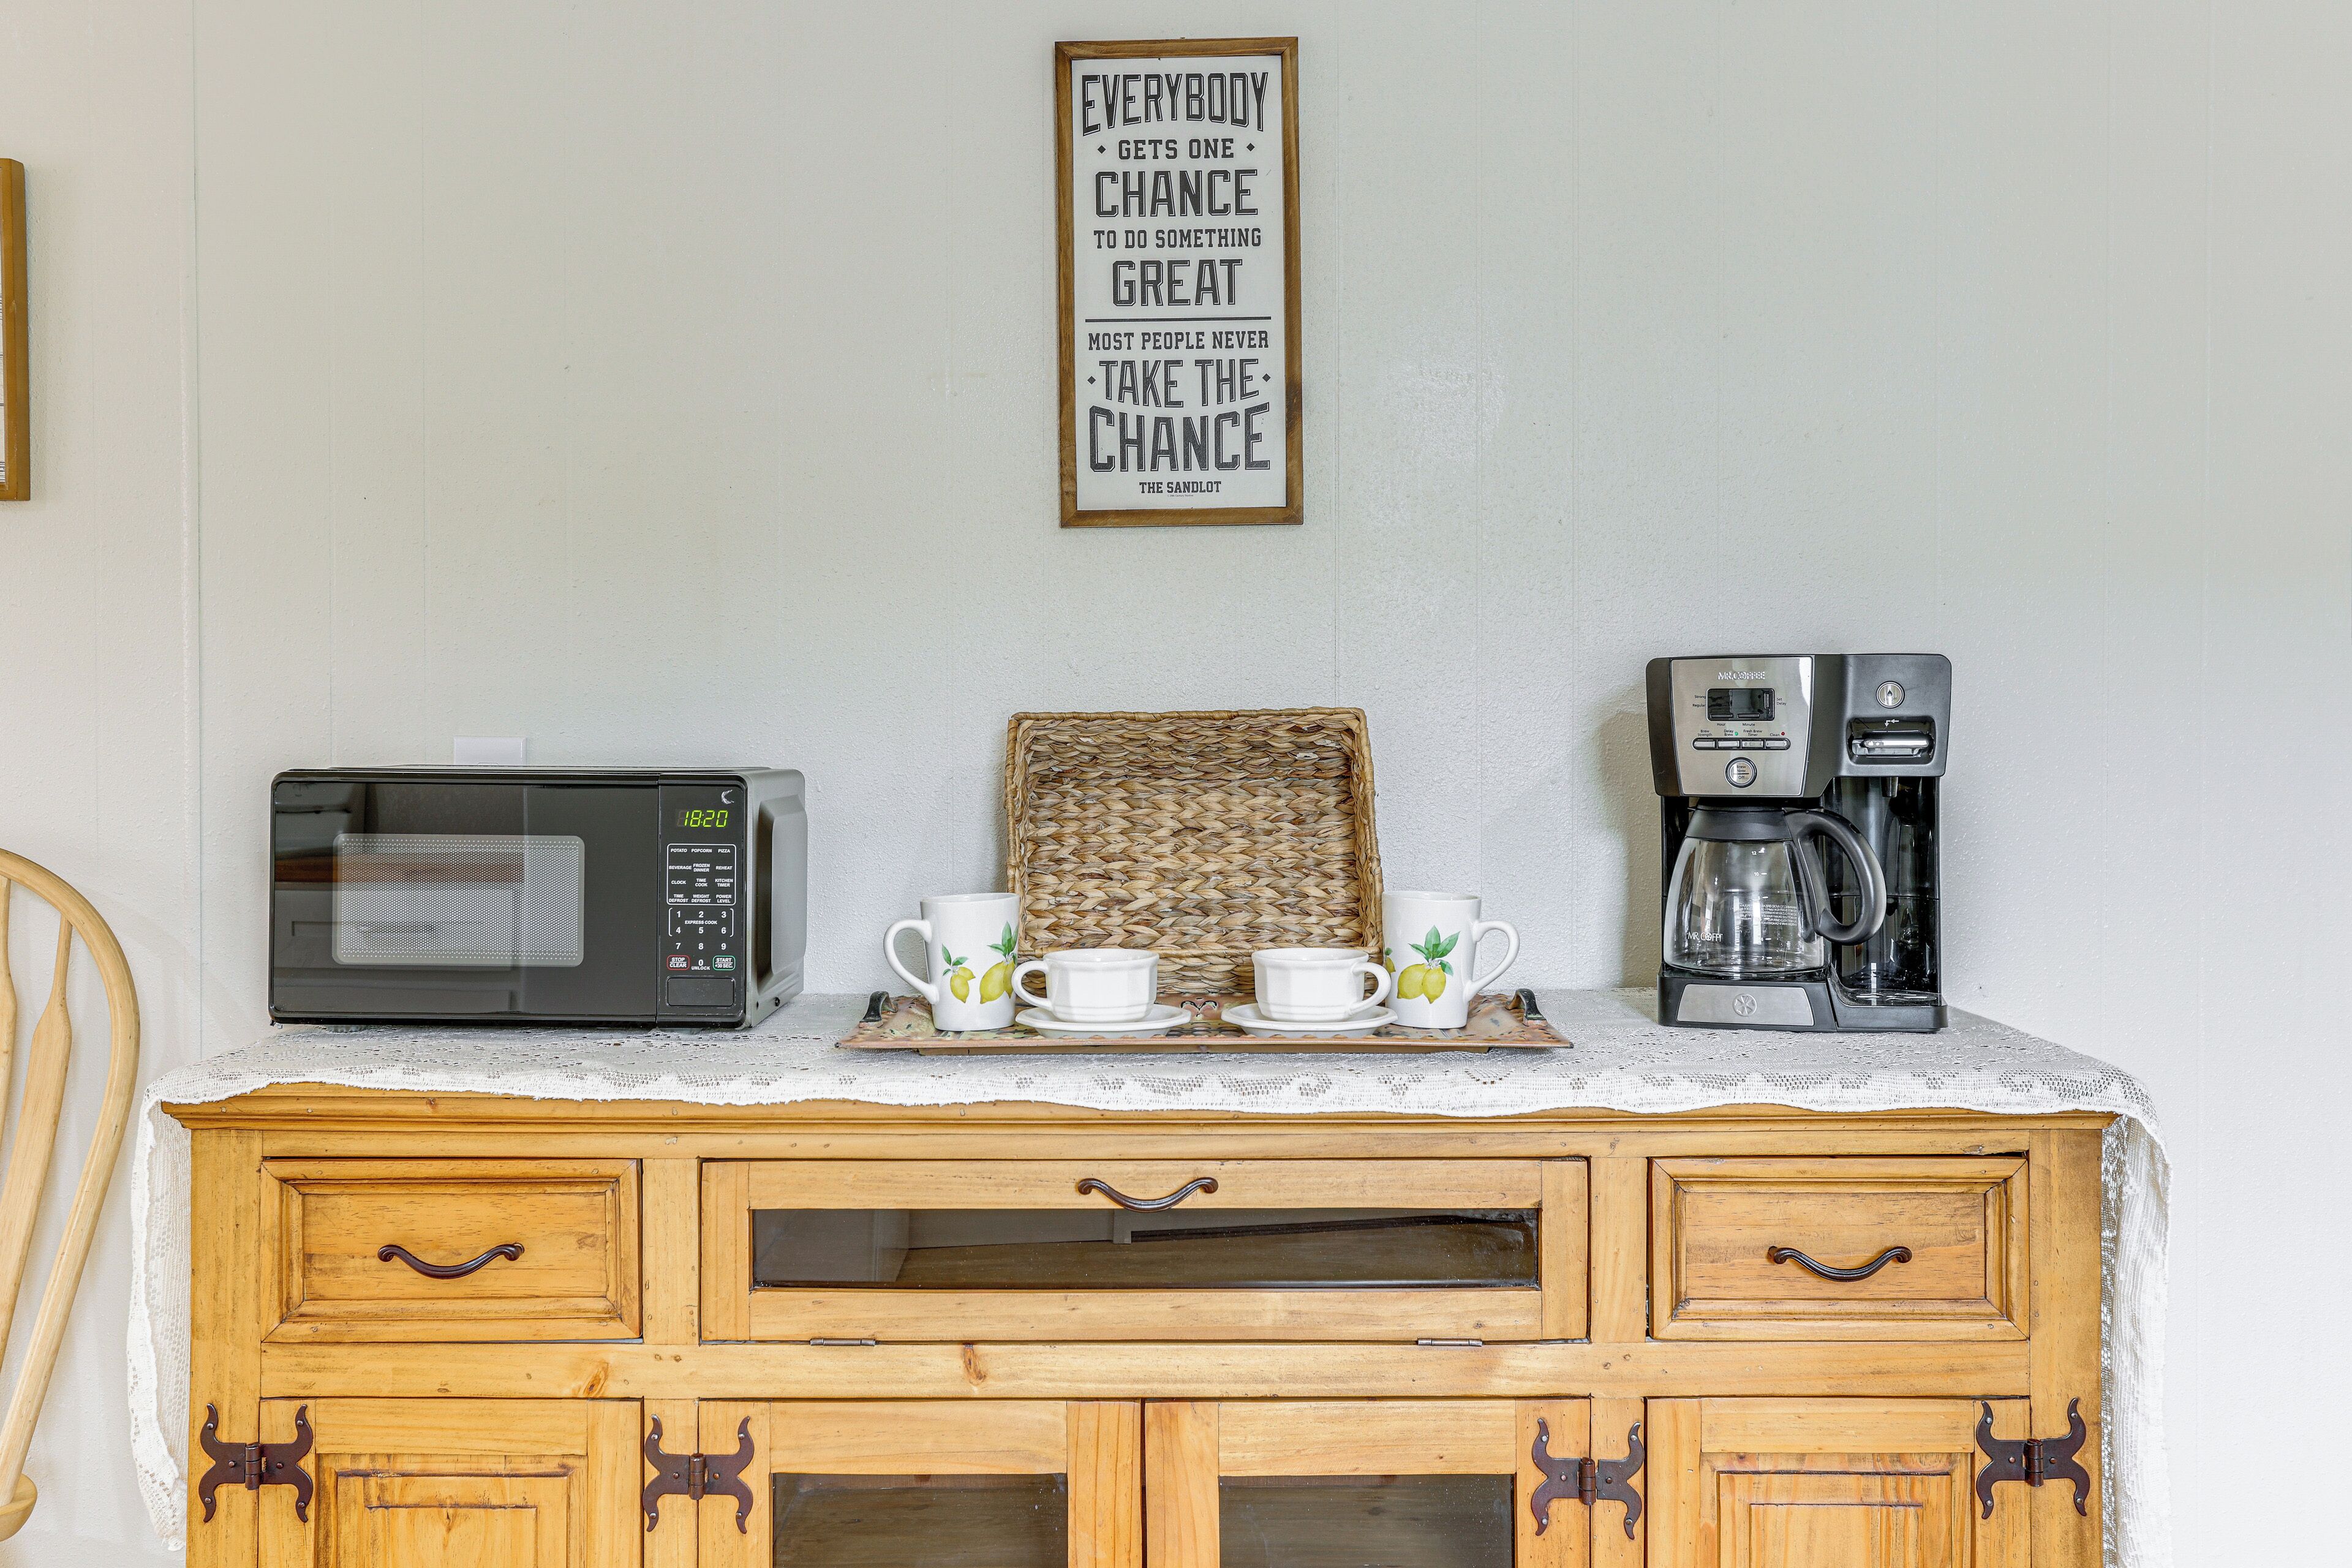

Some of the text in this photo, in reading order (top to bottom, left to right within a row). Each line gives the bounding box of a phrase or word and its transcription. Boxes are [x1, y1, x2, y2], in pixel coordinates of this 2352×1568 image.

[1082, 72, 1268, 136] EVERYBODY
[1118, 138, 1234, 160] GETS ONE
[1096, 170, 1257, 217] CHANCE
[1094, 228, 1261, 249] TO DO SOMETHING
[1113, 259, 1242, 306] GREAT
[1088, 330, 1268, 350] MOST PEOPLE NEVER
[1099, 358, 1259, 407] TAKE THE
[1090, 402, 1270, 472] CHANCE
[1139, 481, 1221, 494] THE SANDLOT
[684, 810, 728, 827] 18:20
[1700, 932, 1723, 942] COFF
